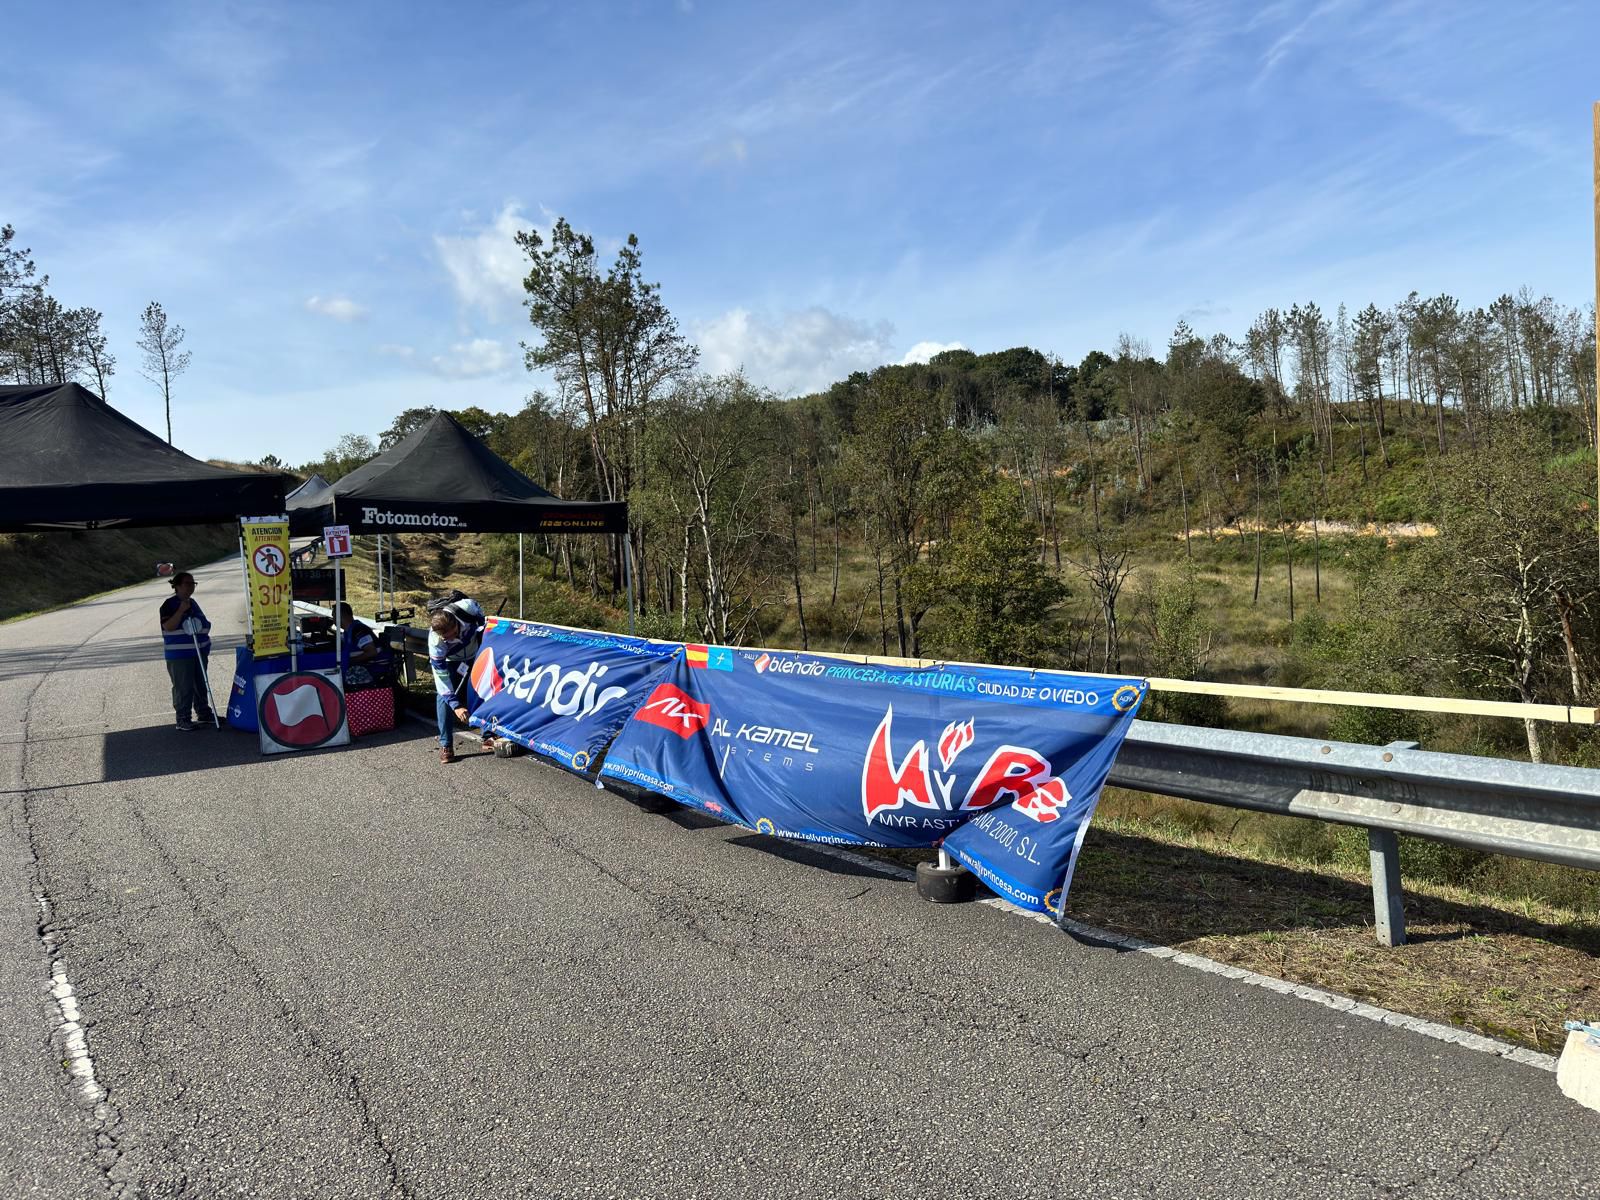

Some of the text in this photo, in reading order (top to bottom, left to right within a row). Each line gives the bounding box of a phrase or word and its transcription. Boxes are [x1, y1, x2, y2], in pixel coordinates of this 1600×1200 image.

[825, 666, 888, 684] PRINCESA
[902, 672, 976, 693] ASTURIAS
[977, 682, 1019, 697] CIUDAD
[1021, 686, 1037, 699] DE
[1039, 687, 1099, 706] OVIEDO
[711, 718, 731, 737] AL
[603, 762, 674, 793] ww.rallyprincesa.com
[879, 813, 918, 828] MYR
[988, 820, 1019, 853] 2000,
[1016, 836, 1042, 866] S.L.
[959, 849, 1039, 906] www.rallyprincesa.com
